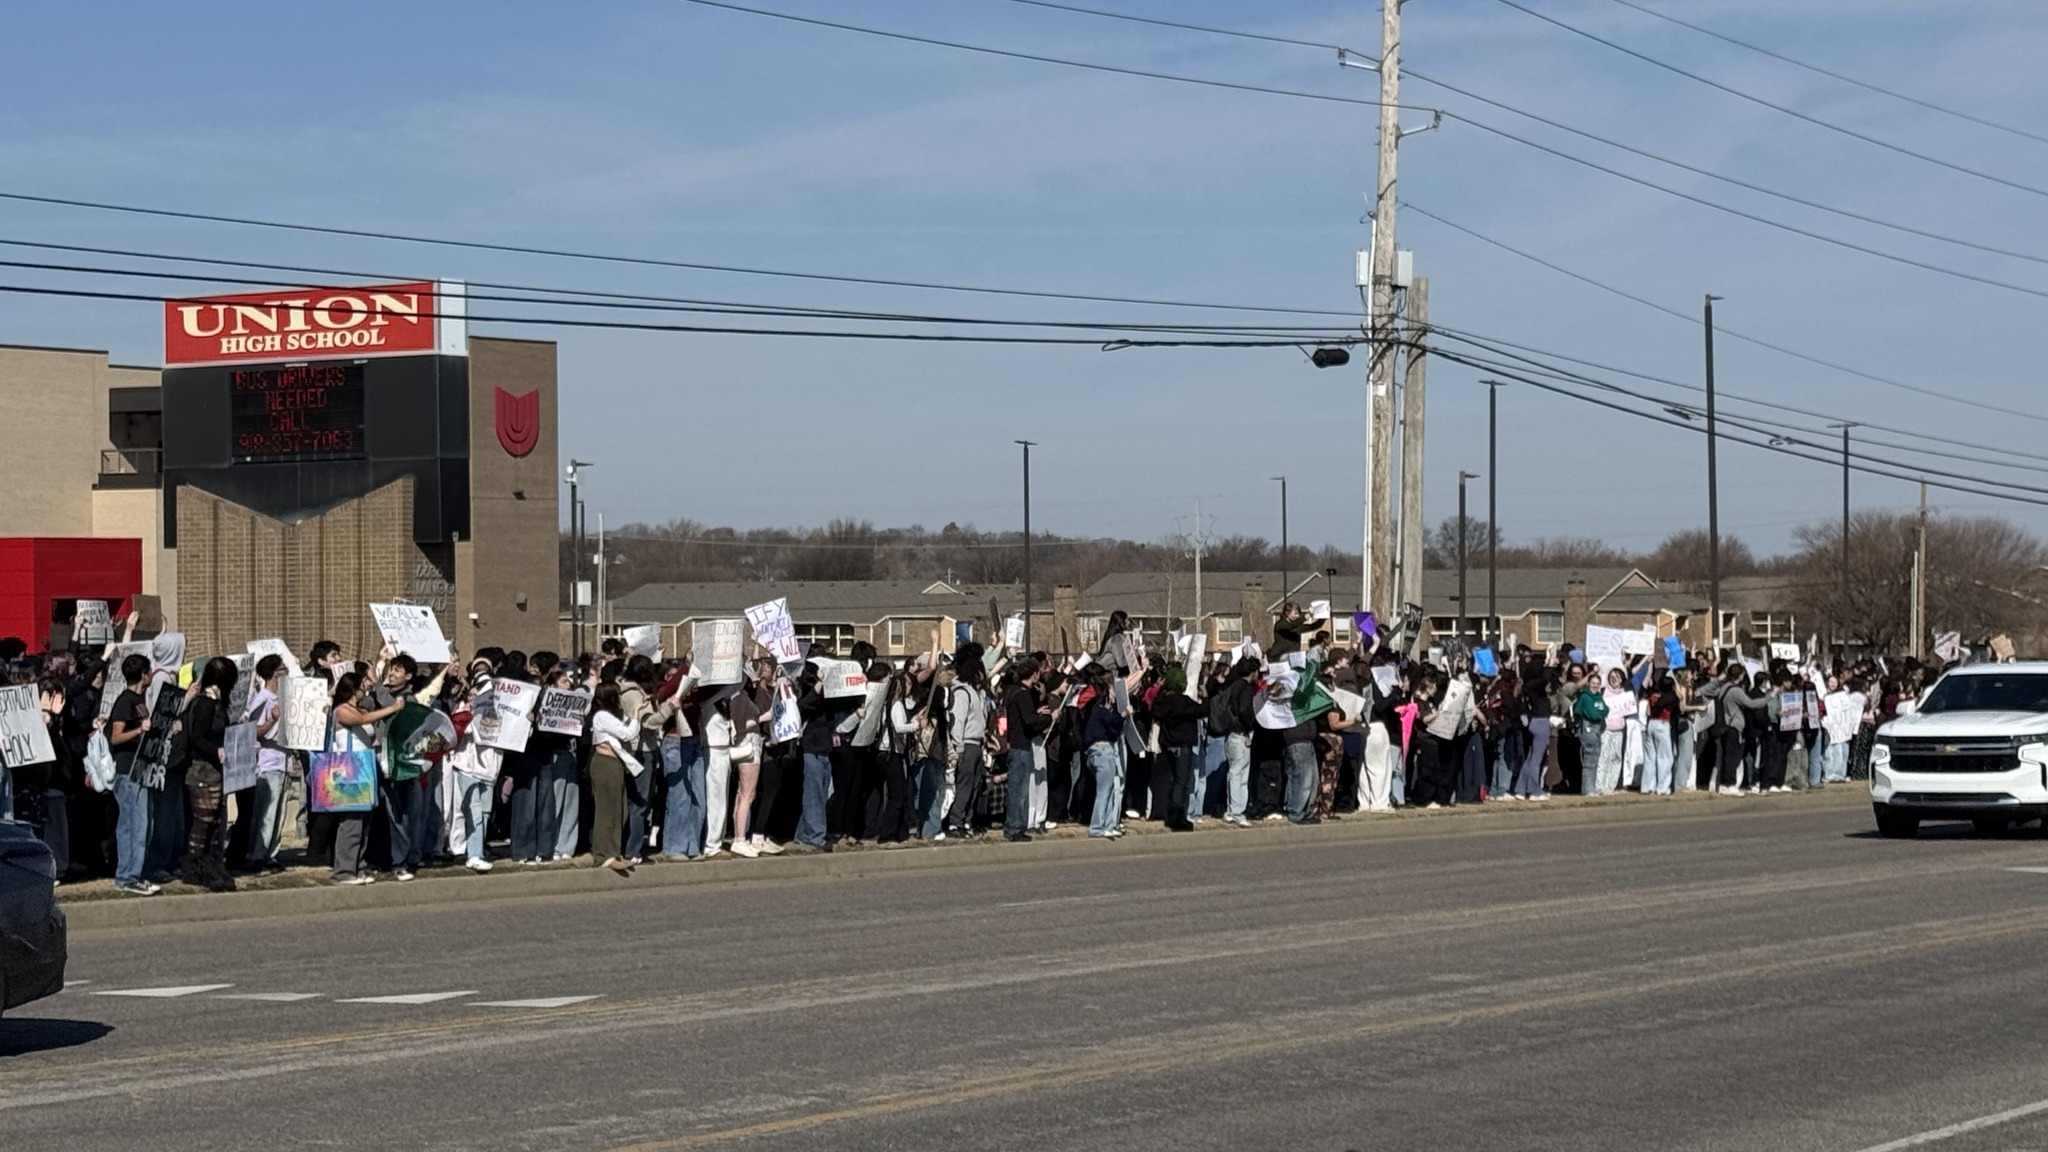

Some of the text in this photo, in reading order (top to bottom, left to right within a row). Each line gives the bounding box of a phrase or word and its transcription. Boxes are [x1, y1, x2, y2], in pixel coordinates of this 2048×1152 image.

[177, 293, 419, 338] UNION
[220, 328, 386, 354] HIGH SCHOOL
[265, 388, 327, 411] NEEDED
[375, 606, 420, 620] WE ALL
[493, 681, 521, 696] TAND
